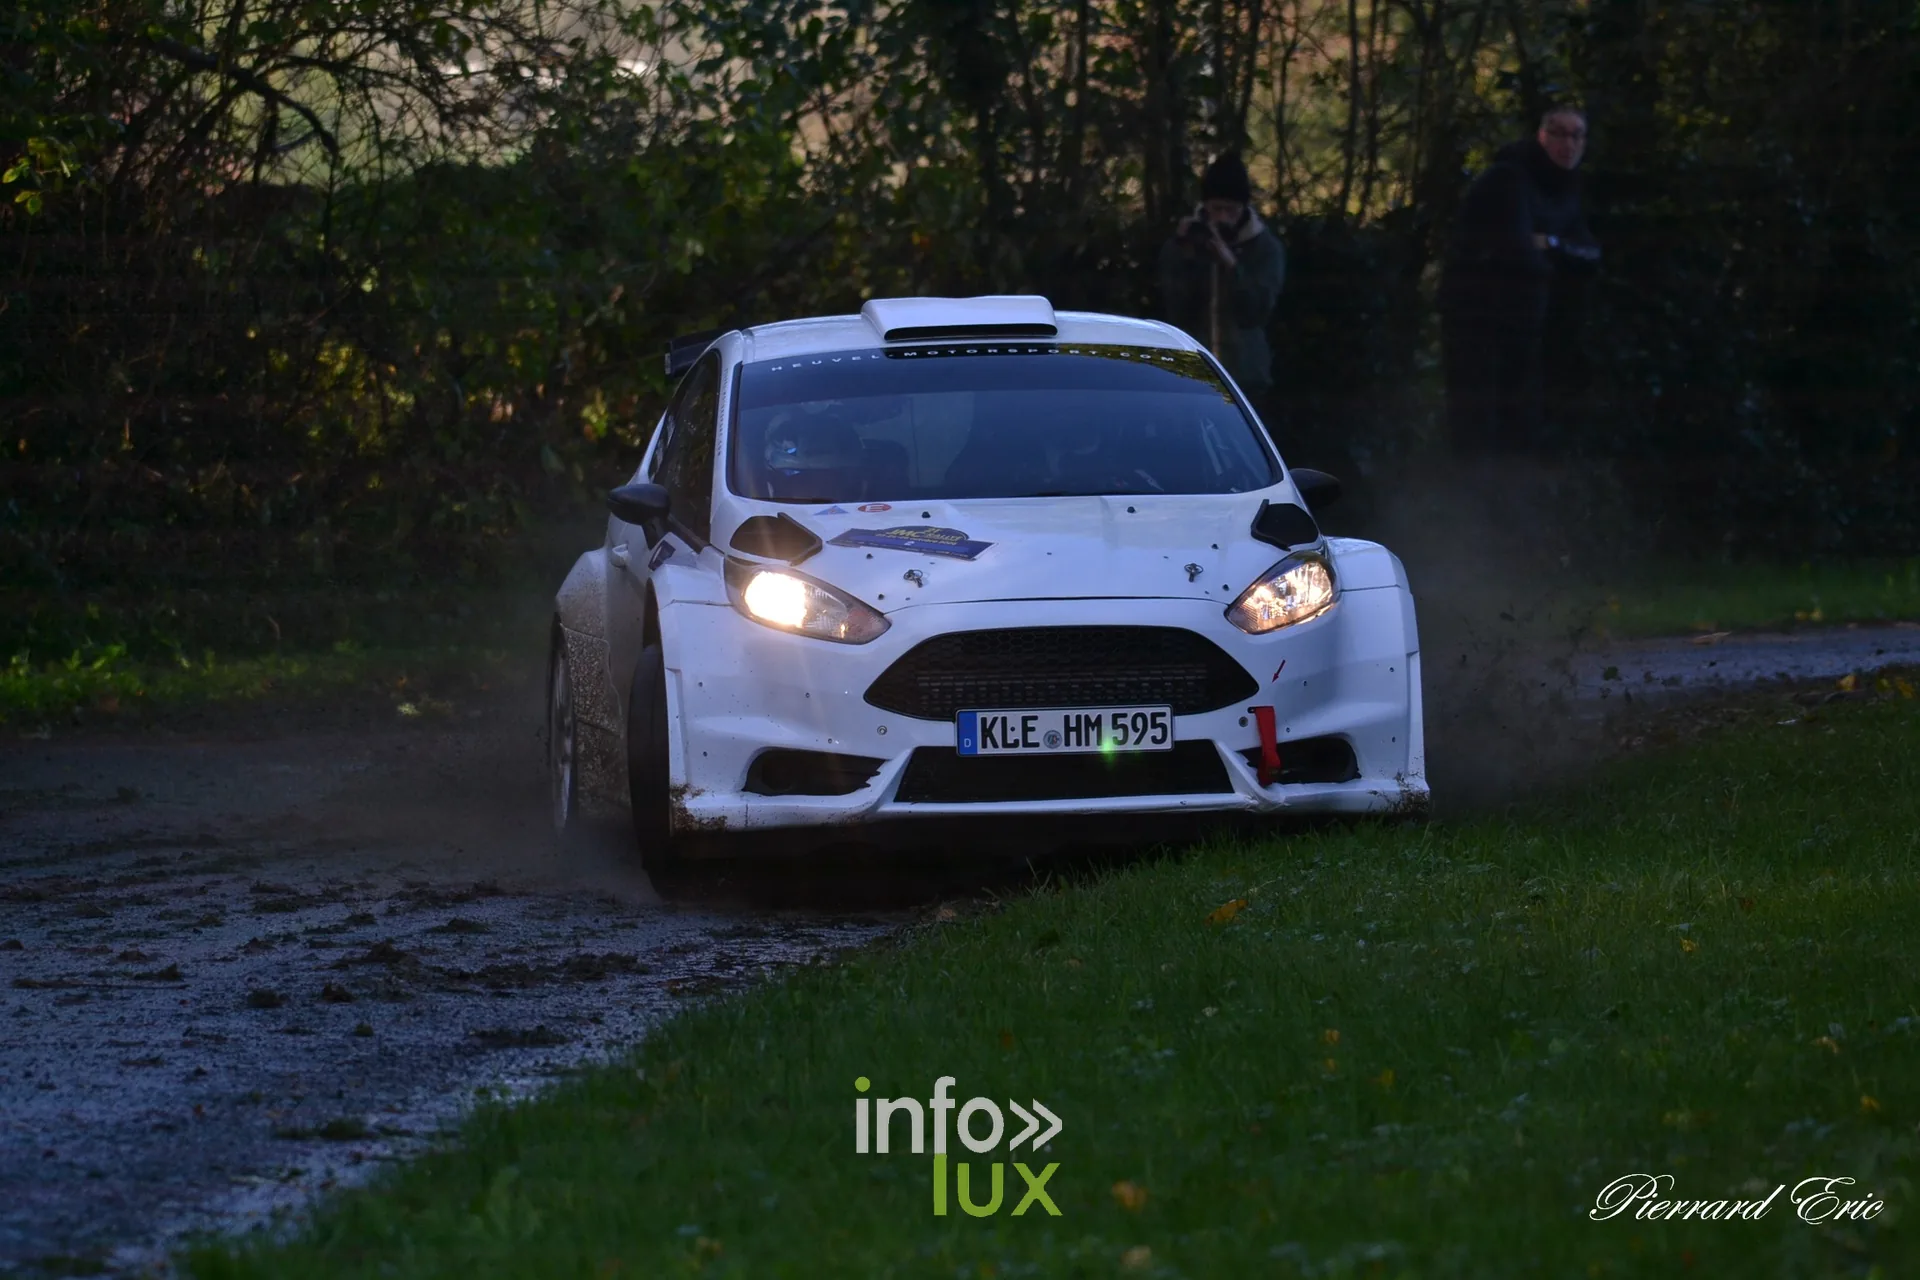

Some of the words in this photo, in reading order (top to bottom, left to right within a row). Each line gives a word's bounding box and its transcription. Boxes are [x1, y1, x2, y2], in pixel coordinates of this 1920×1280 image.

[980, 715, 1040, 749] KLE
[1063, 714, 1103, 747] HM
[1111, 711, 1169, 746] 595
[963, 738, 972, 748] D
